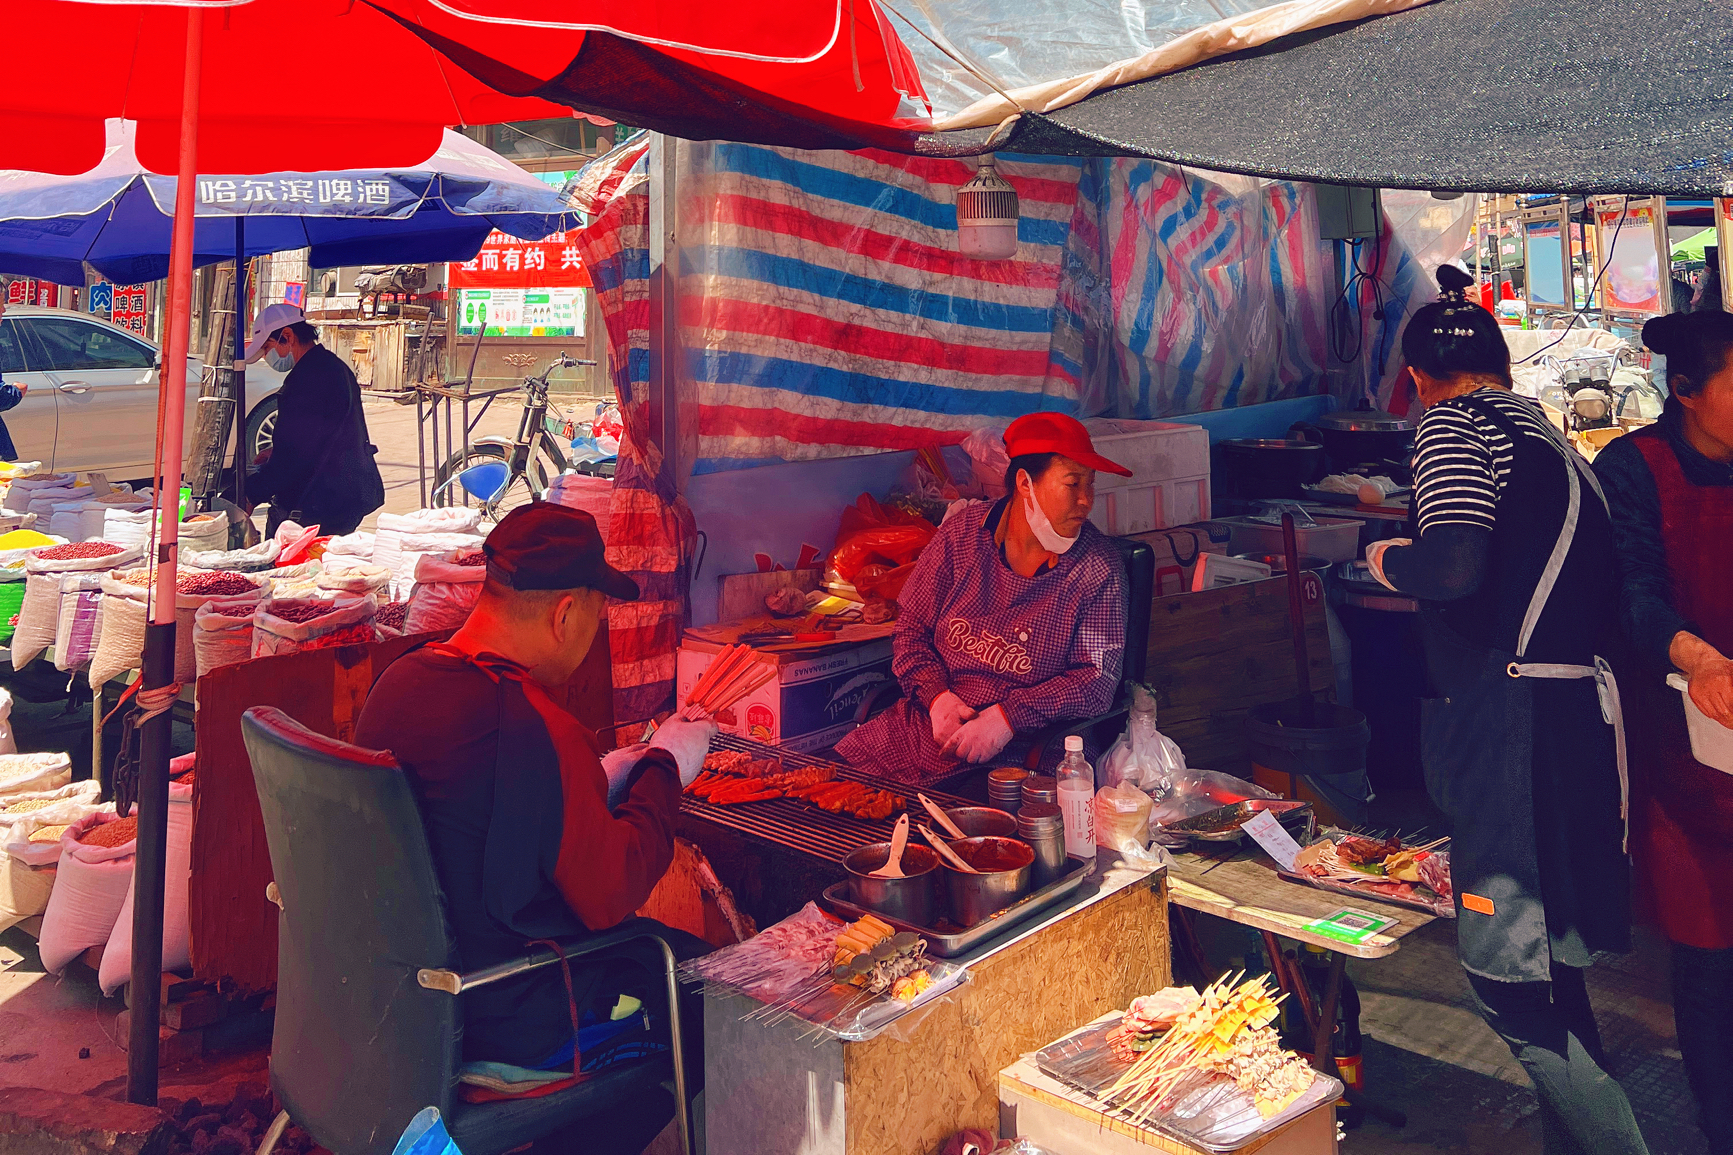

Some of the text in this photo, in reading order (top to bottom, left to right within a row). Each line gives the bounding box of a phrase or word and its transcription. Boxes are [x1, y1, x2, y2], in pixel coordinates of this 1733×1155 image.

[200, 179, 390, 205] 哈尔滨啤酒
[561, 246, 582, 270] 共
[88, 281, 112, 314] 肉
[115, 295, 143, 313] 啤酒
[1305, 580, 1317, 600] 13
[946, 618, 1033, 674] Beatific
[794, 663, 827, 676] BANANAS
[1084, 797, 1096, 845] 凉白开
